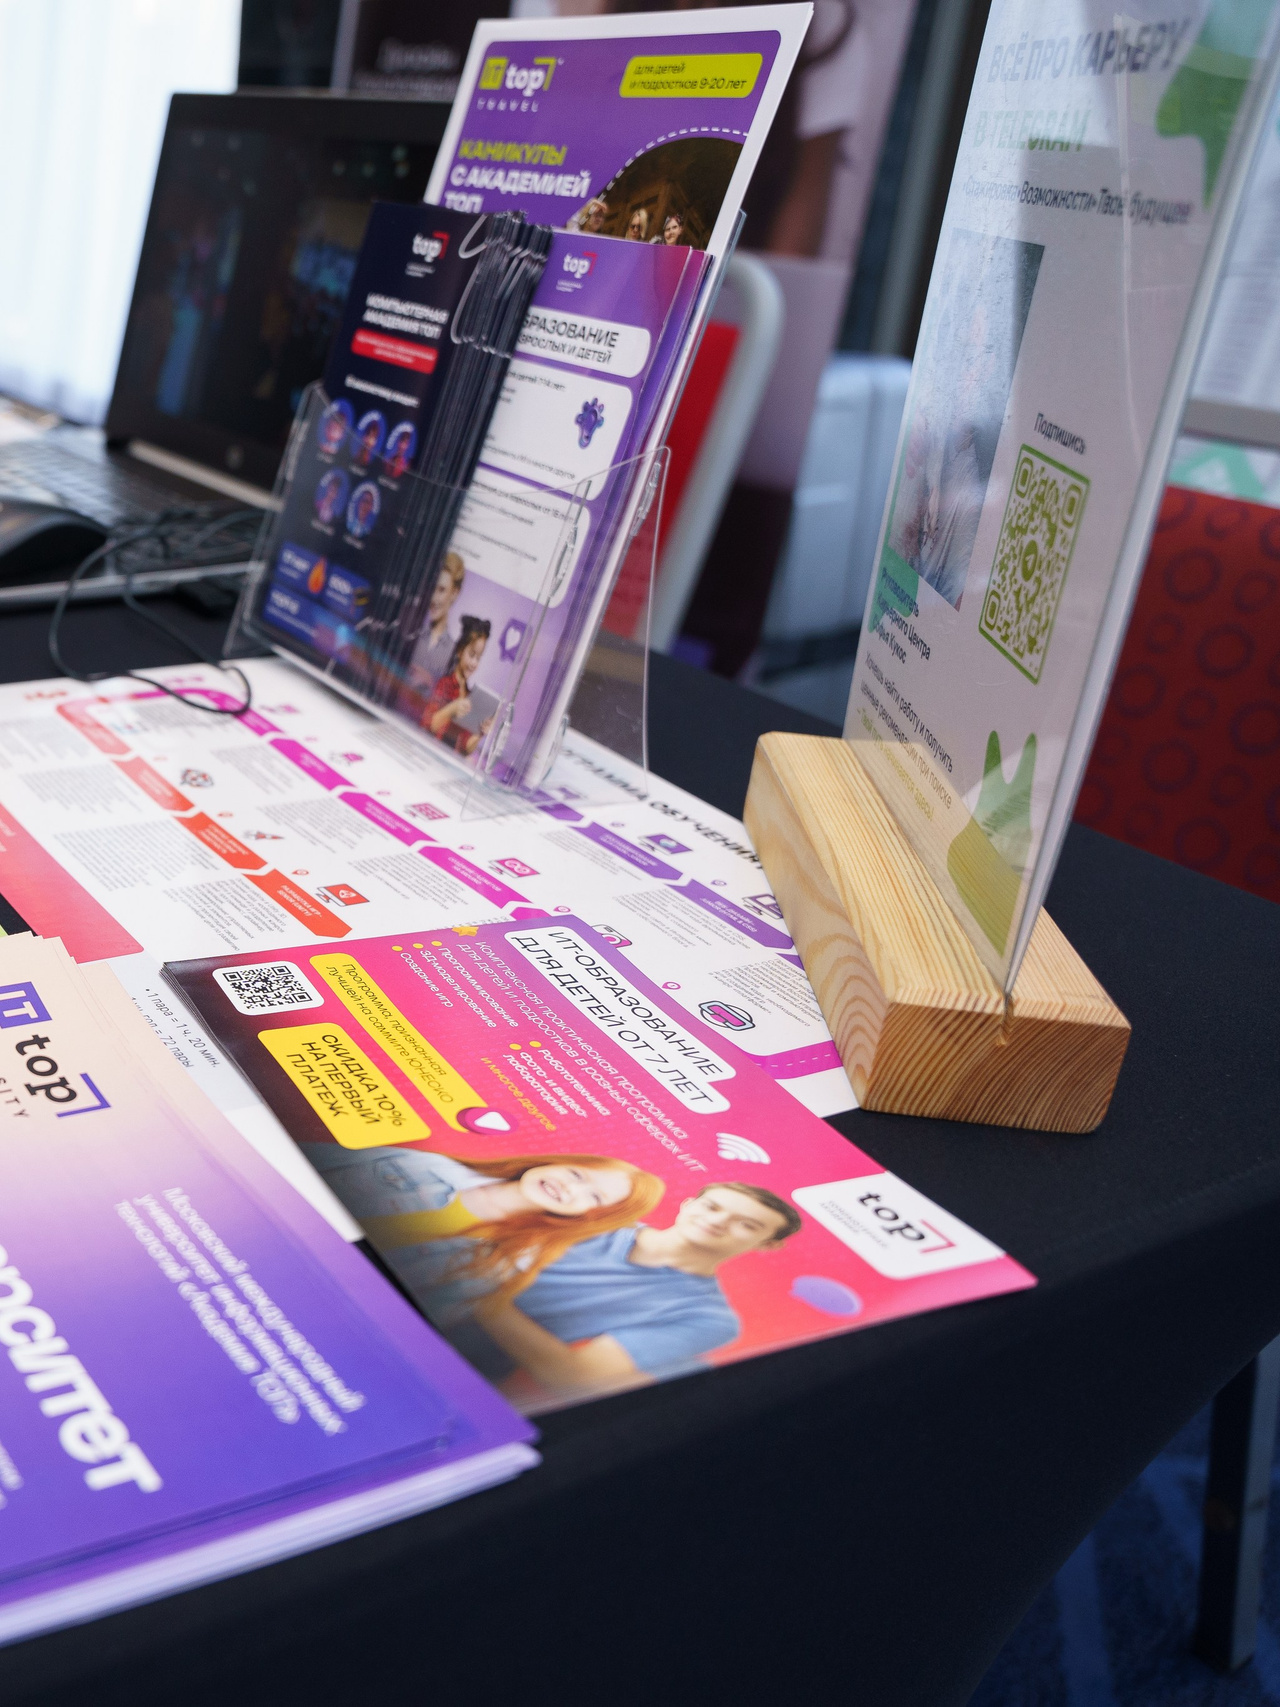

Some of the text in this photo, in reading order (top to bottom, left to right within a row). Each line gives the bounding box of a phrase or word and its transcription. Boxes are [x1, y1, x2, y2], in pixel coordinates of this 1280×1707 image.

[505, 64, 545, 95] top
[1024, 38, 1068, 81] ПРО
[1073, 20, 1188, 79] КАРЬЕРУ
[698, 77, 725, 90] 9-20
[726, 78, 748, 90] лет
[458, 139, 567, 166] КАНИКУЛЫ
[468, 169, 592, 198] АКАДЕМИЕЙ
[445, 191, 484, 214] ТОП
[412, 233, 442, 262] top
[562, 253, 591, 279] top
[518, 333, 612, 364] ЗРОСЛЫХ ДЕТЕЙ
[521, 313, 619, 348] БРАЗОВАНИЕ
[1033, 413, 1086, 455] Подпишись
[889, 634, 907, 664] Кукос
[907, 624, 931, 660] Центра
[860, 679, 952, 809] ценные рекомендации при поиске
[884, 676, 901, 705] найти
[899, 697, 921, 733] работу
[924, 728, 953, 774] получить
[400, 951, 454, 1008] Создание игр
[438, 947, 519, 1028] Программирование
[548, 932, 723, 1076] ИТ-ОБРАЗОВАНИЕ
[151, 996, 173, 1017] пара
[188, 1038, 206, 1049] 20
[199, 1049, 220, 1068] мин.
[325, 966, 454, 1104] лучшей на саммите ЮНЕСКО
[341, 963, 448, 1077] Программа, признанная
[474, 941, 689, 1140] Комплексная практическая программа
[511, 936, 715, 1102] ДЛЯ ДЕТЕЙ ОТ 7 ЛЕТ
[15, 1033, 78, 1104] top
[170, 1046, 194, 1069] пары
[286, 1053, 349, 1117] ПЛАТЕЖ
[301, 1041, 384, 1125] НА ПЕРВЫЙ
[321, 1034, 407, 1128] СКИДКА 10%
[456, 943, 482, 961] для
[475, 961, 510, 991] детей
[513, 999, 579, 1060] подростков
[581, 1066, 633, 1107] разных
[626, 1106, 682, 1155] сферах
[677, 1152, 709, 1173] ИТ
[502, 1053, 569, 1116] лаборатория
[538, 1049, 612, 1116] Робототехника
[488, 1064, 524, 1098] многое
[517, 1097, 557, 1131] другое
[162, 1186, 250, 1277] Московский
[858, 1191, 926, 1242] top
